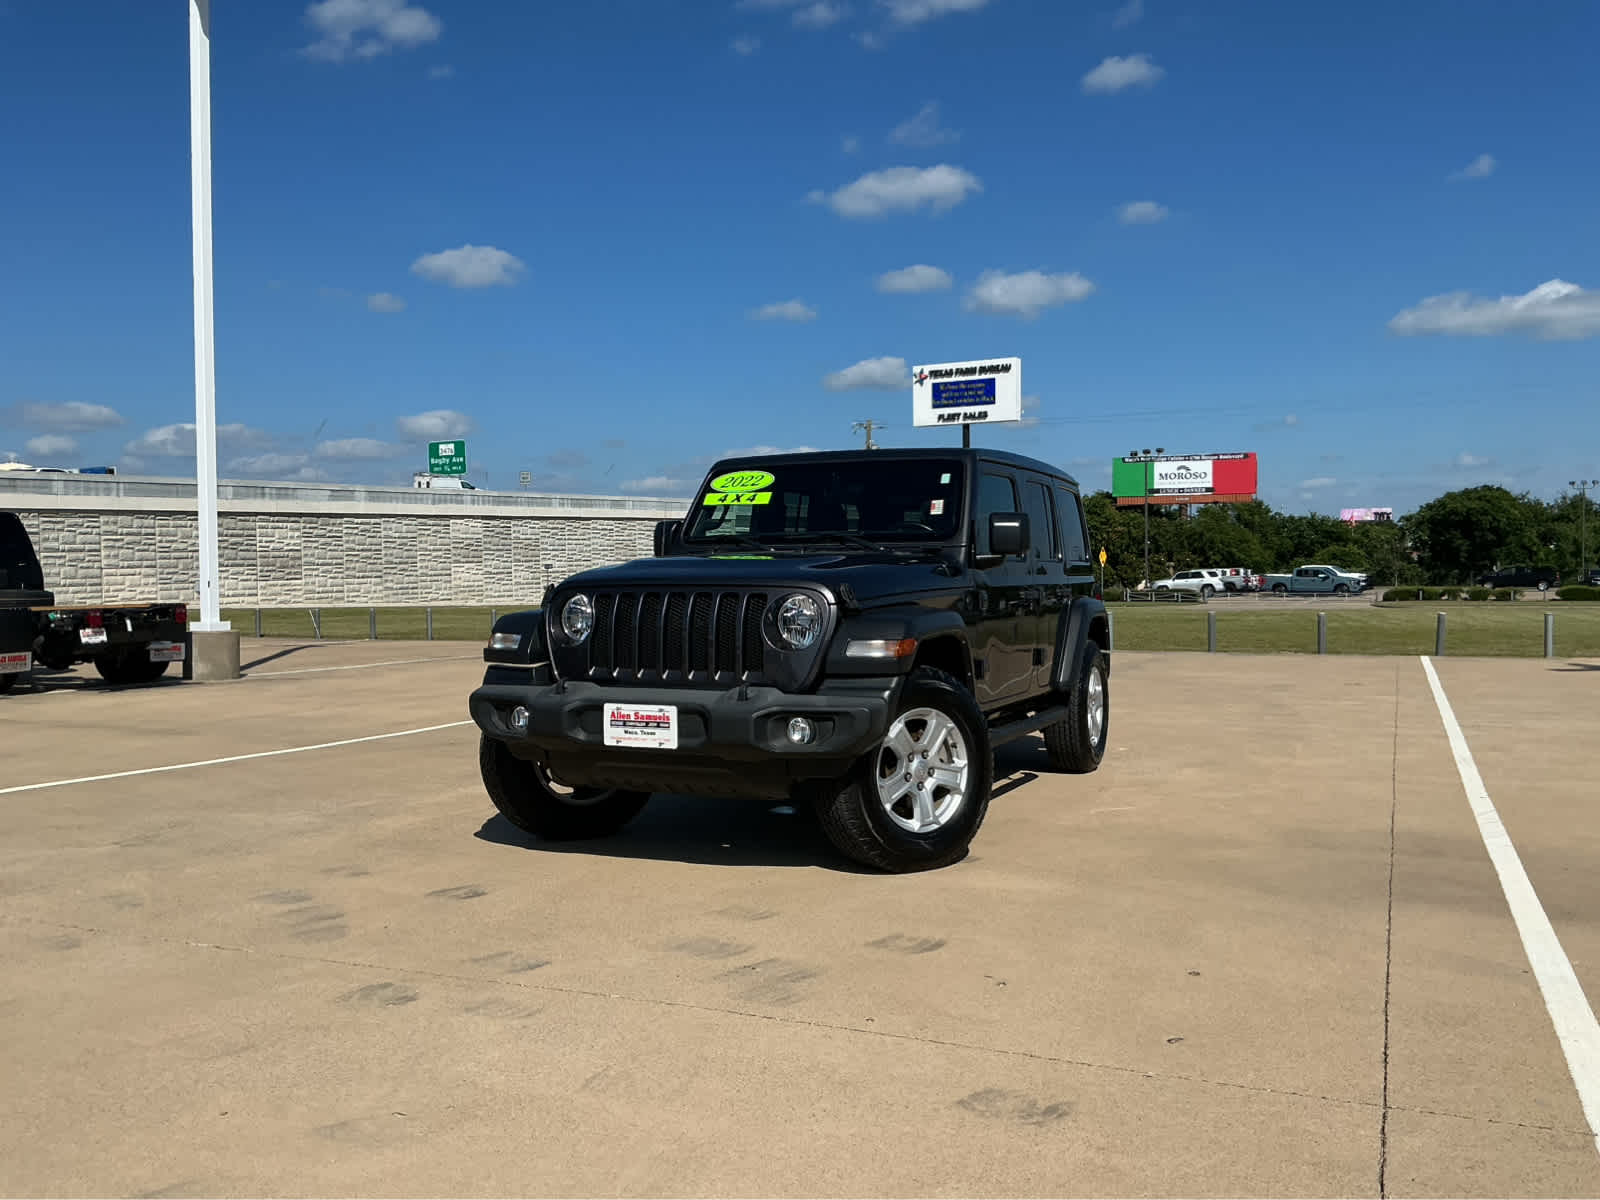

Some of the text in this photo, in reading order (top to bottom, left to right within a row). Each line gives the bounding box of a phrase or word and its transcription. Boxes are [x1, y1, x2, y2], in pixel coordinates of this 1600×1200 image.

[928, 363, 1012, 380] TEXAS FARM BUREAU
[937, 411, 988, 423] FLEET SALES
[720, 474, 765, 488] 2022
[1158, 471, 1208, 481] MOROSO
[610, 711, 671, 722] Allen Samuels
